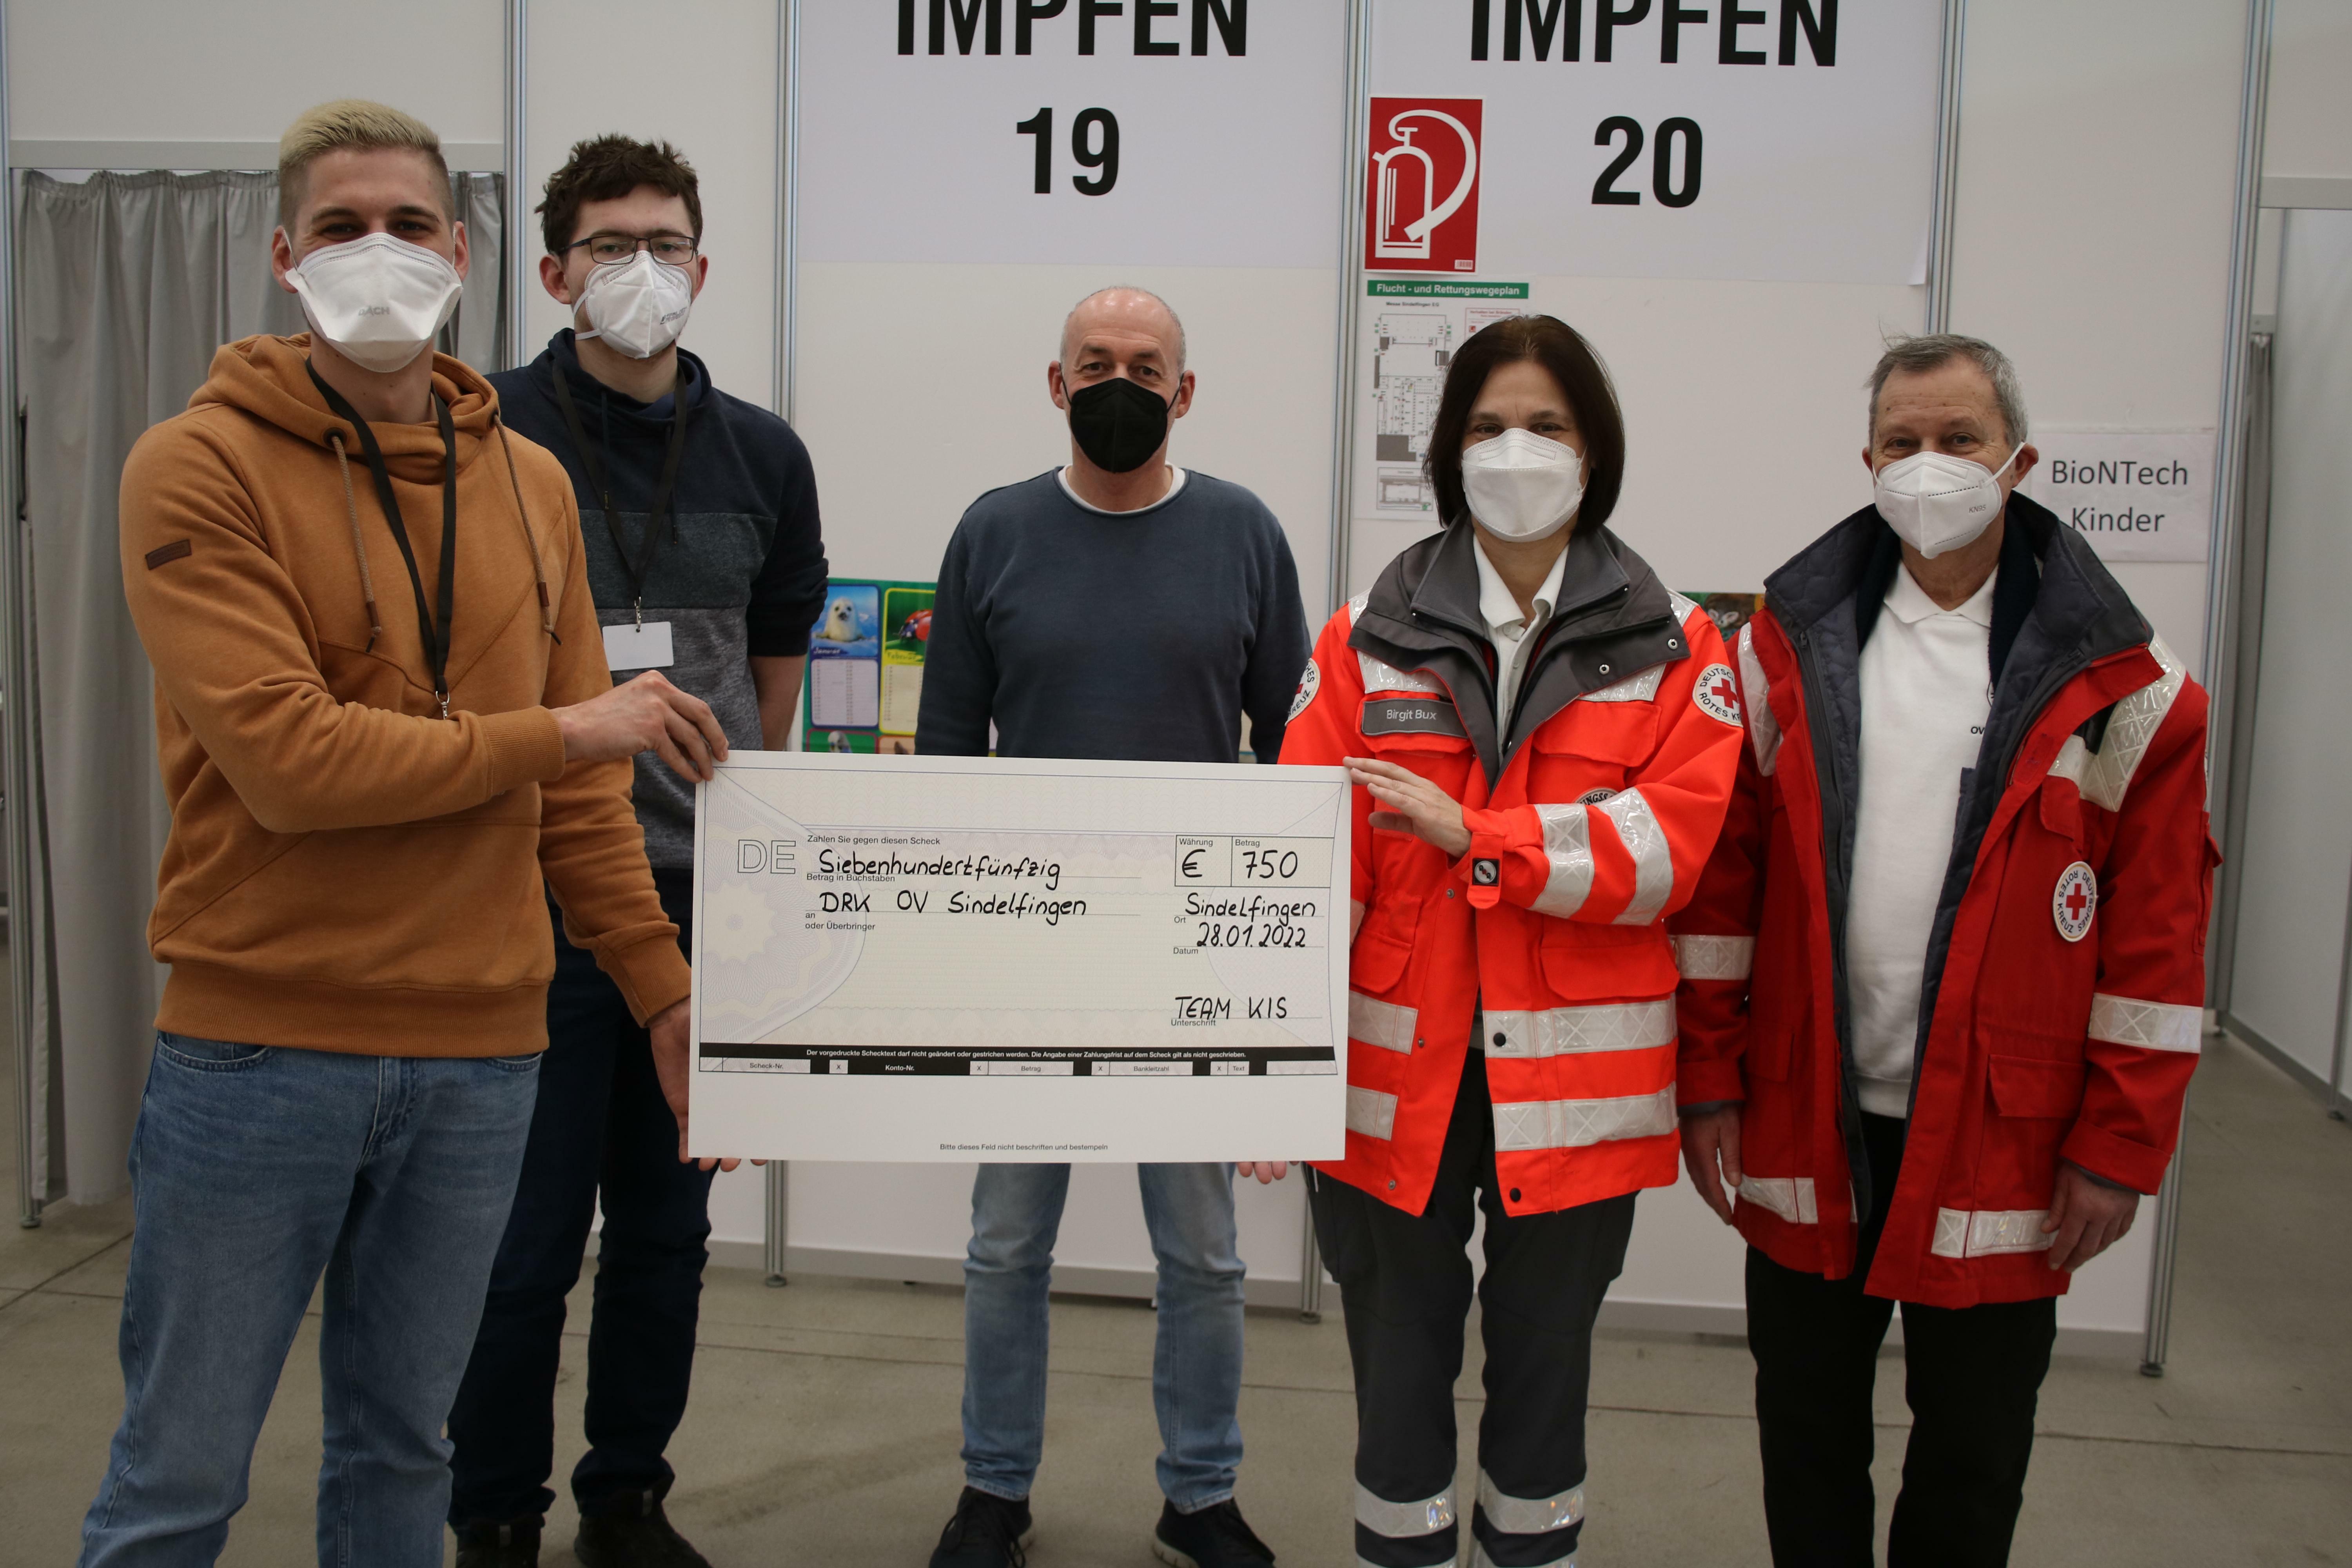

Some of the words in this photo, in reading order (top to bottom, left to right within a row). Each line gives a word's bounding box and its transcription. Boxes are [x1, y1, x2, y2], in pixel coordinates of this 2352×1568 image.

[898, 0, 1247, 56] IMPFEN
[1470, 0, 1838, 67] IMPFEN
[1016, 107, 1120, 196] 19
[1591, 116, 1703, 208] 20
[1377, 283, 1406, 293] Flucht
[1414, 284, 1431, 293] und
[1434, 285, 1520, 296] Rettungswegeplan
[2052, 460, 2188, 485] BioNTech
[1969, 504, 1986, 513] KN95
[2072, 506, 2165, 532] Kinder
[1699, 668, 1734, 687] DEUTSC
[1386, 709, 1413, 722] Birgit
[1415, 709, 1437, 720] Bux
[1699, 692, 1728, 717] ROTES
[807, 835, 835, 843] Zahlen
[838, 835, 851, 844] Sie
[853, 837, 878, 846] gegen
[880, 836, 908, 844] diesen
[910, 837, 941, 845] Scheck
[1179, 838, 1213, 847] Währung
[1234, 839, 1260, 848] Betrag
[737, 839, 797, 875] DE
[819, 848, 1061, 891] Siebenhundertfünfzig
[1181, 848, 1206, 878] €
[1242, 849, 1298, 879] 750
[806, 873, 834, 882] Betrag
[836, 873, 844, 882] in
[846, 873, 895, 882] Buchstaben
[2058, 869, 2078, 898] ROTES
[819, 891, 871, 913] DRK
[897, 889, 929, 914] OV
[947, 890, 1087, 926] Sindelfingen
[1185, 892, 1316, 927] Sindelfingen
[2057, 903, 2074, 933] KREUZ
[805, 922, 824, 930] oder
[826, 920, 876, 932] Überbringer
[1196, 922, 1306, 948] 28.01.2022
[1175, 996, 1231, 1020] TEAM
[1249, 996, 1288, 1019] KIS
